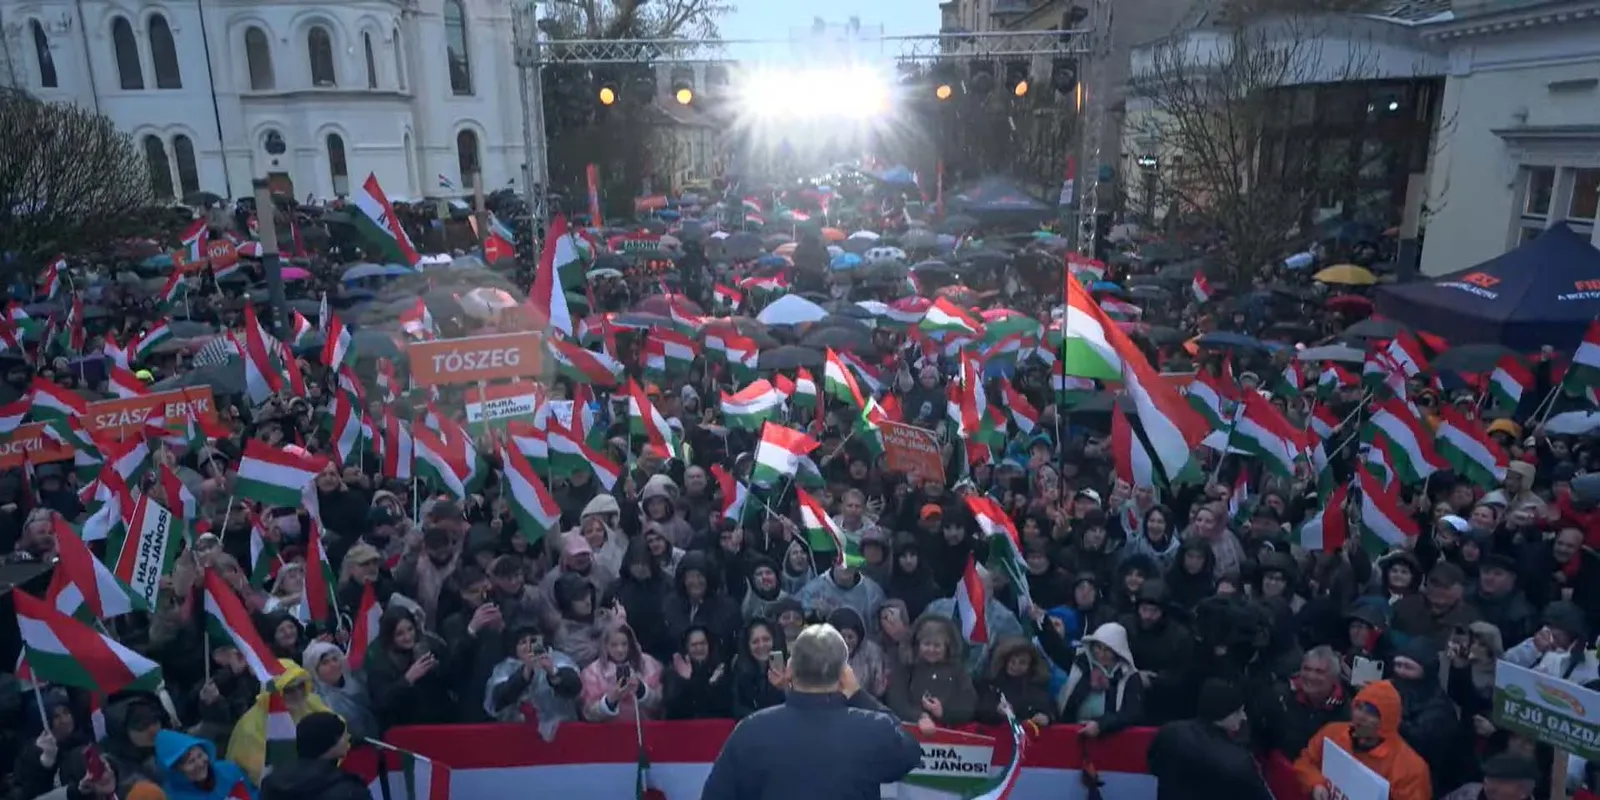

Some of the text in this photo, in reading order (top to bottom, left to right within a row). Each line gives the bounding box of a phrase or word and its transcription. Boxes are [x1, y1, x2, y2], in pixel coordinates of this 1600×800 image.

[432, 348, 520, 373] TÓSZEG
[152, 509, 168, 564] JÁNOS!
[137, 530, 155, 583] HAJRÁ,
[920, 747, 962, 762] AJRÁ,
[930, 760, 987, 773] JÁNOS!
